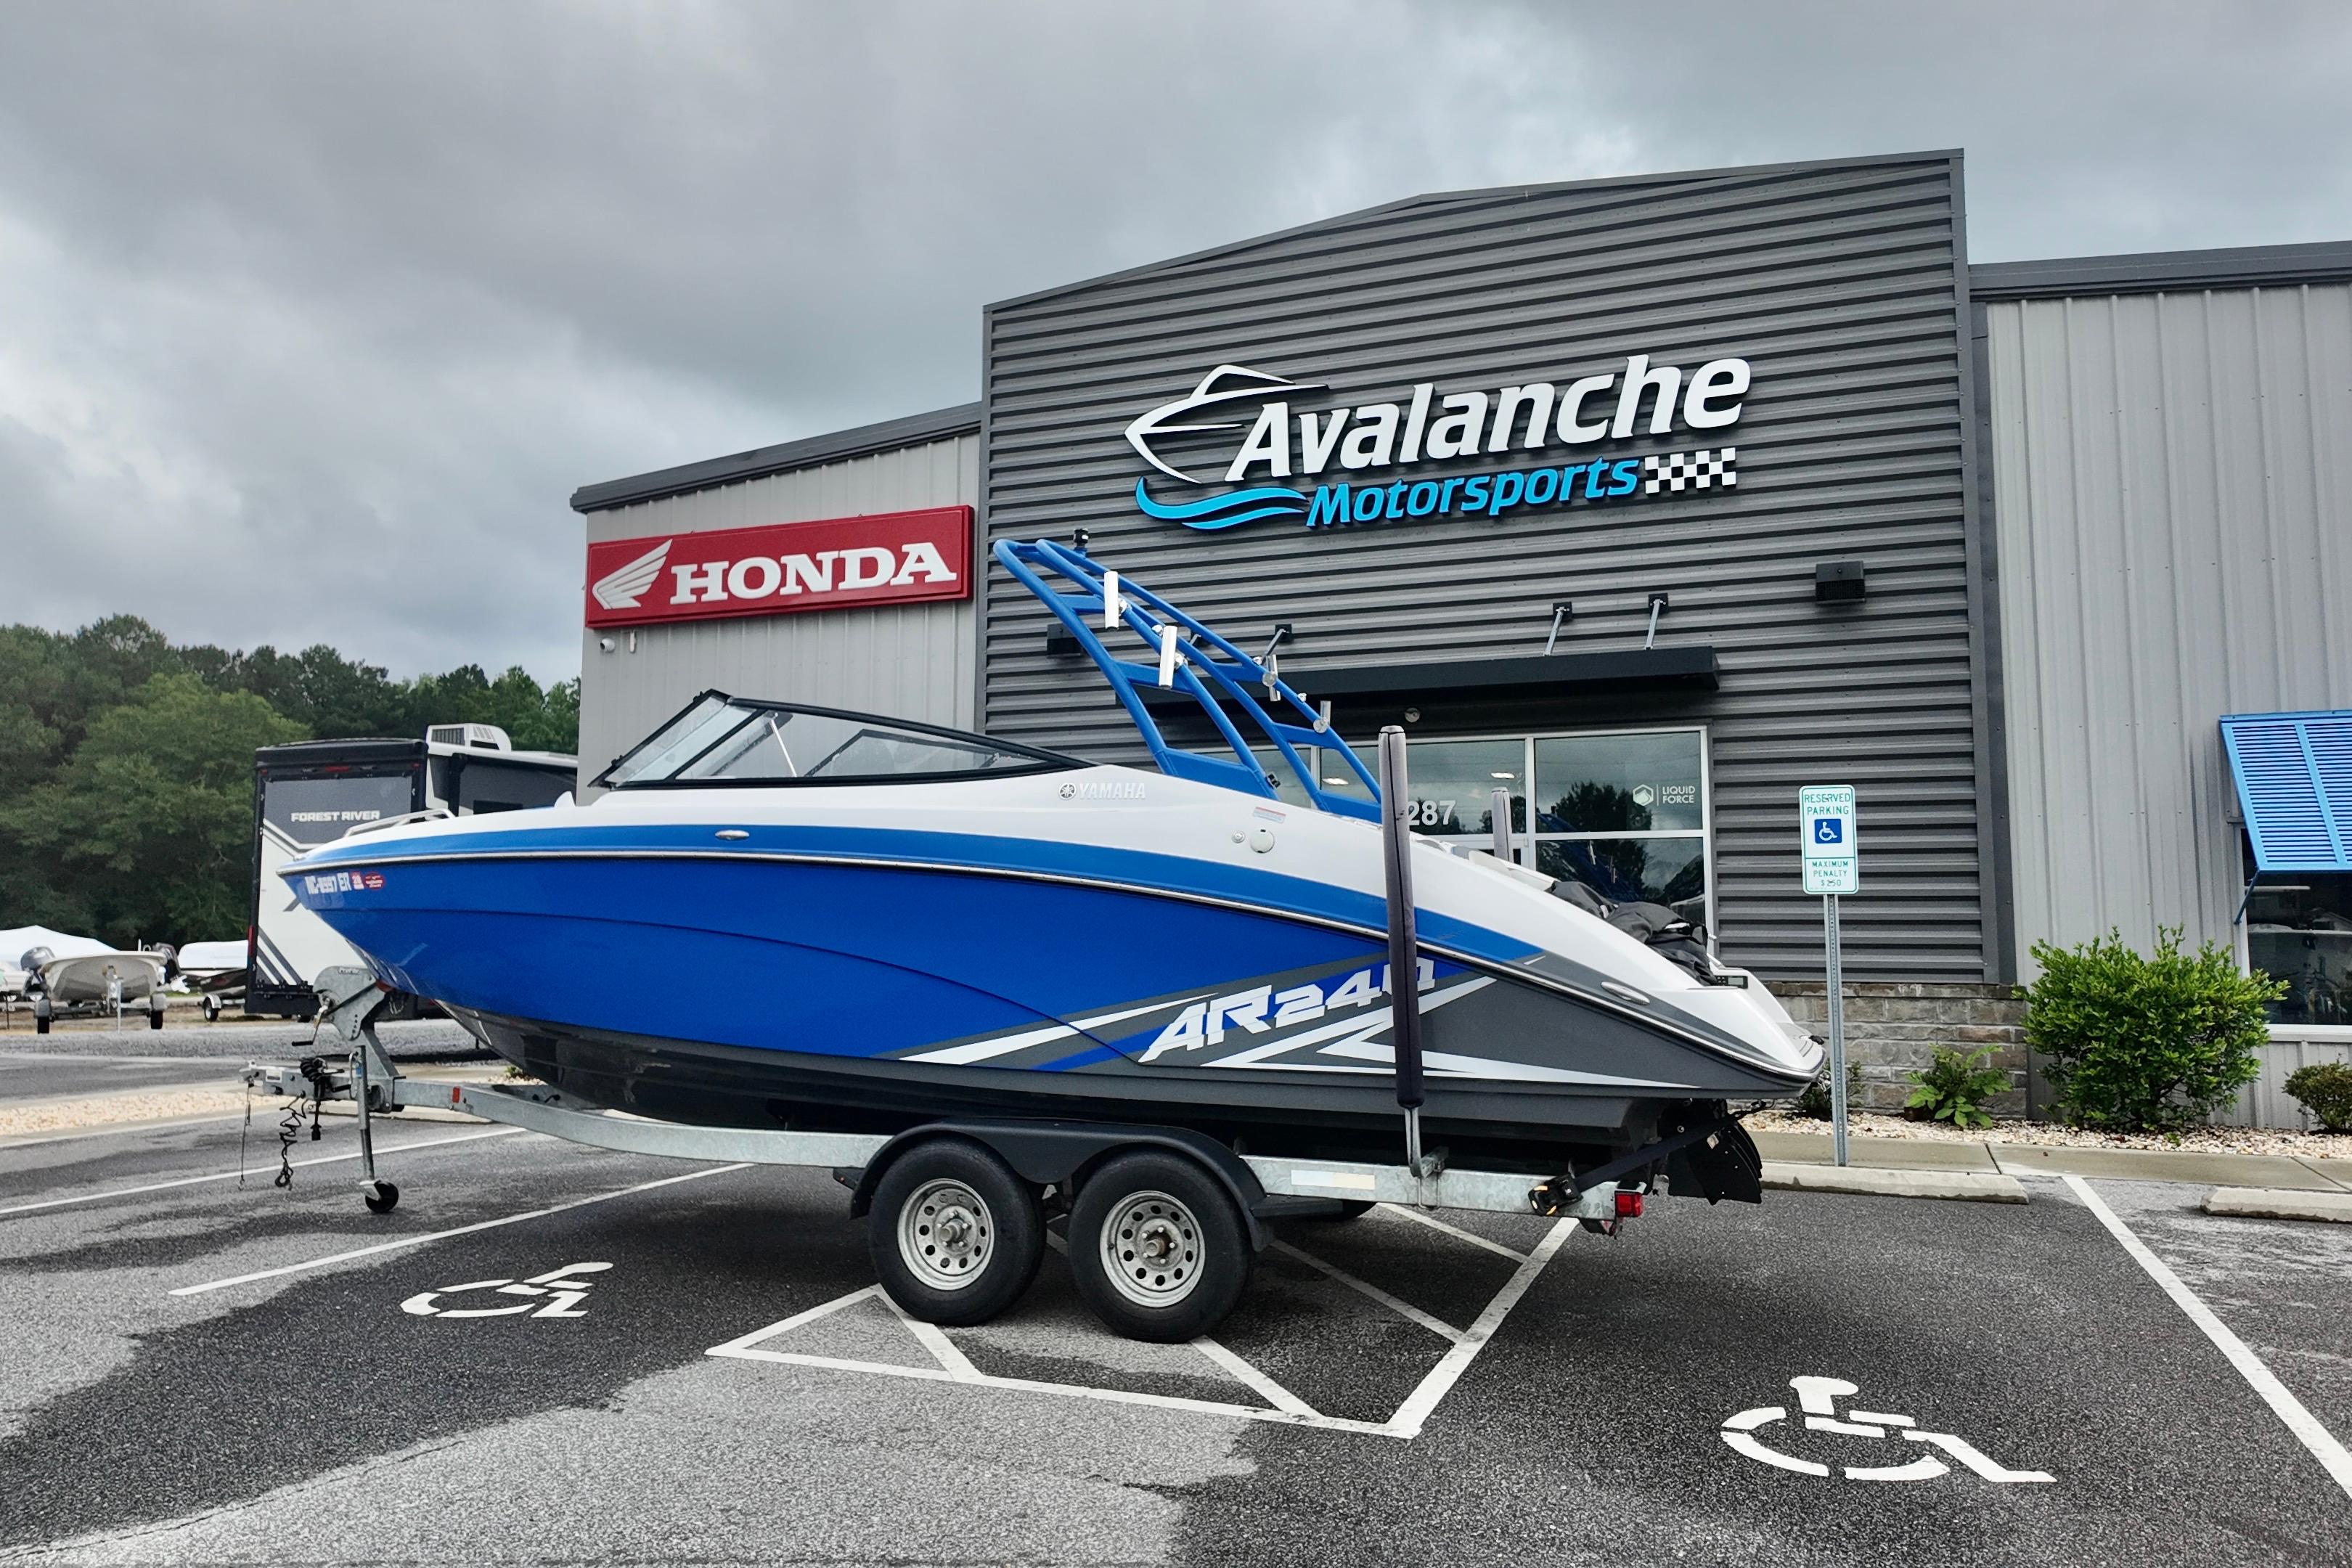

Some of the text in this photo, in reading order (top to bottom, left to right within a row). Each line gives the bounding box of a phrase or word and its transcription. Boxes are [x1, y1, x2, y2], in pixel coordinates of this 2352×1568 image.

[1224, 354, 1752, 483] Avalanche
[1306, 456, 1641, 527] Motorsports
[669, 542, 957, 605] HONDA
[1079, 783, 1146, 799] YAMAHA
[1662, 785, 1696, 795] LIQUID
[1662, 795, 1695, 804] FORCE
[1804, 793, 1850, 803] RESERVED
[290, 810, 380, 822] FOREST RIVER
[1408, 800, 1456, 826] 287
[1807, 805, 1849, 815] PARKING
